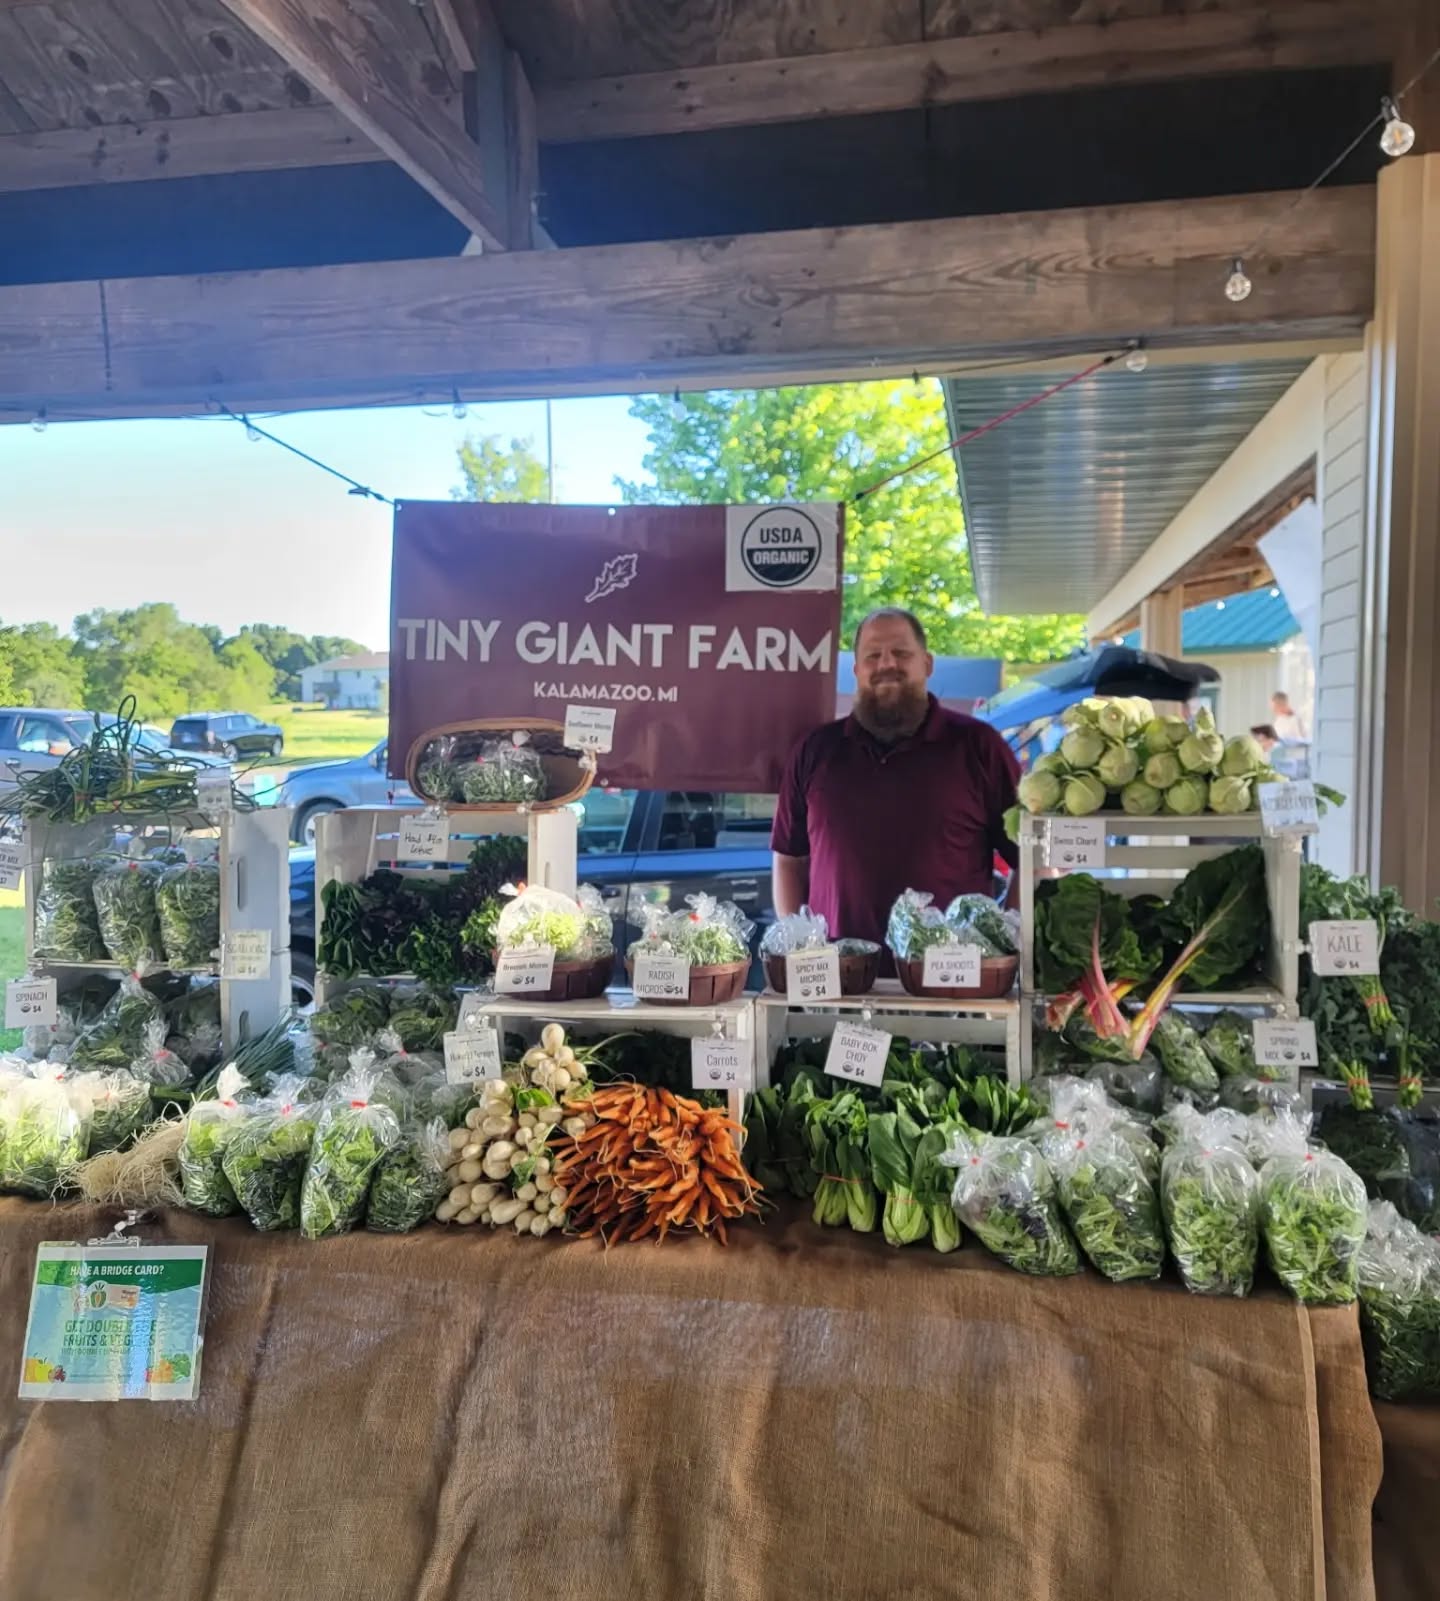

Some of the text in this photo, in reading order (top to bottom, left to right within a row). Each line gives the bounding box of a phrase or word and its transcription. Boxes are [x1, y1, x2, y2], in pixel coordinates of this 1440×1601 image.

[760, 527, 803, 544] USDA
[753, 550, 809, 565] ORGANIC
[398, 618, 833, 673] TINY GIANT FARM
[1076, 854, 1088, 863] $4
[1327, 935, 1362, 953] KALE
[795, 962, 829, 974] SPICY MIX
[930, 961, 944, 970] PEA
[525, 975, 536, 984] $4
[648, 970, 675, 980] RADISH
[800, 974, 826, 984] MICROS
[955, 974, 965, 983] $4
[636, 984, 664, 994] MICROS
[815, 985, 826, 996] $4
[15, 992, 48, 1002] SPINACH
[33, 1005, 42, 1013] $4
[840, 1036, 878, 1054] BABY BOK
[706, 1055, 738, 1066] Carrots
[846, 1050, 868, 1063] CHOY
[1300, 1051, 1311, 1061] $4
[474, 1065, 486, 1077] $4
[726, 1072, 736, 1081] $4
[93, 1265, 100, 1275] A
[101, 1265, 133, 1276] BRIDGE
[134, 1264, 165, 1275] CARD?
[64, 1334, 98, 1347] FRUITS
